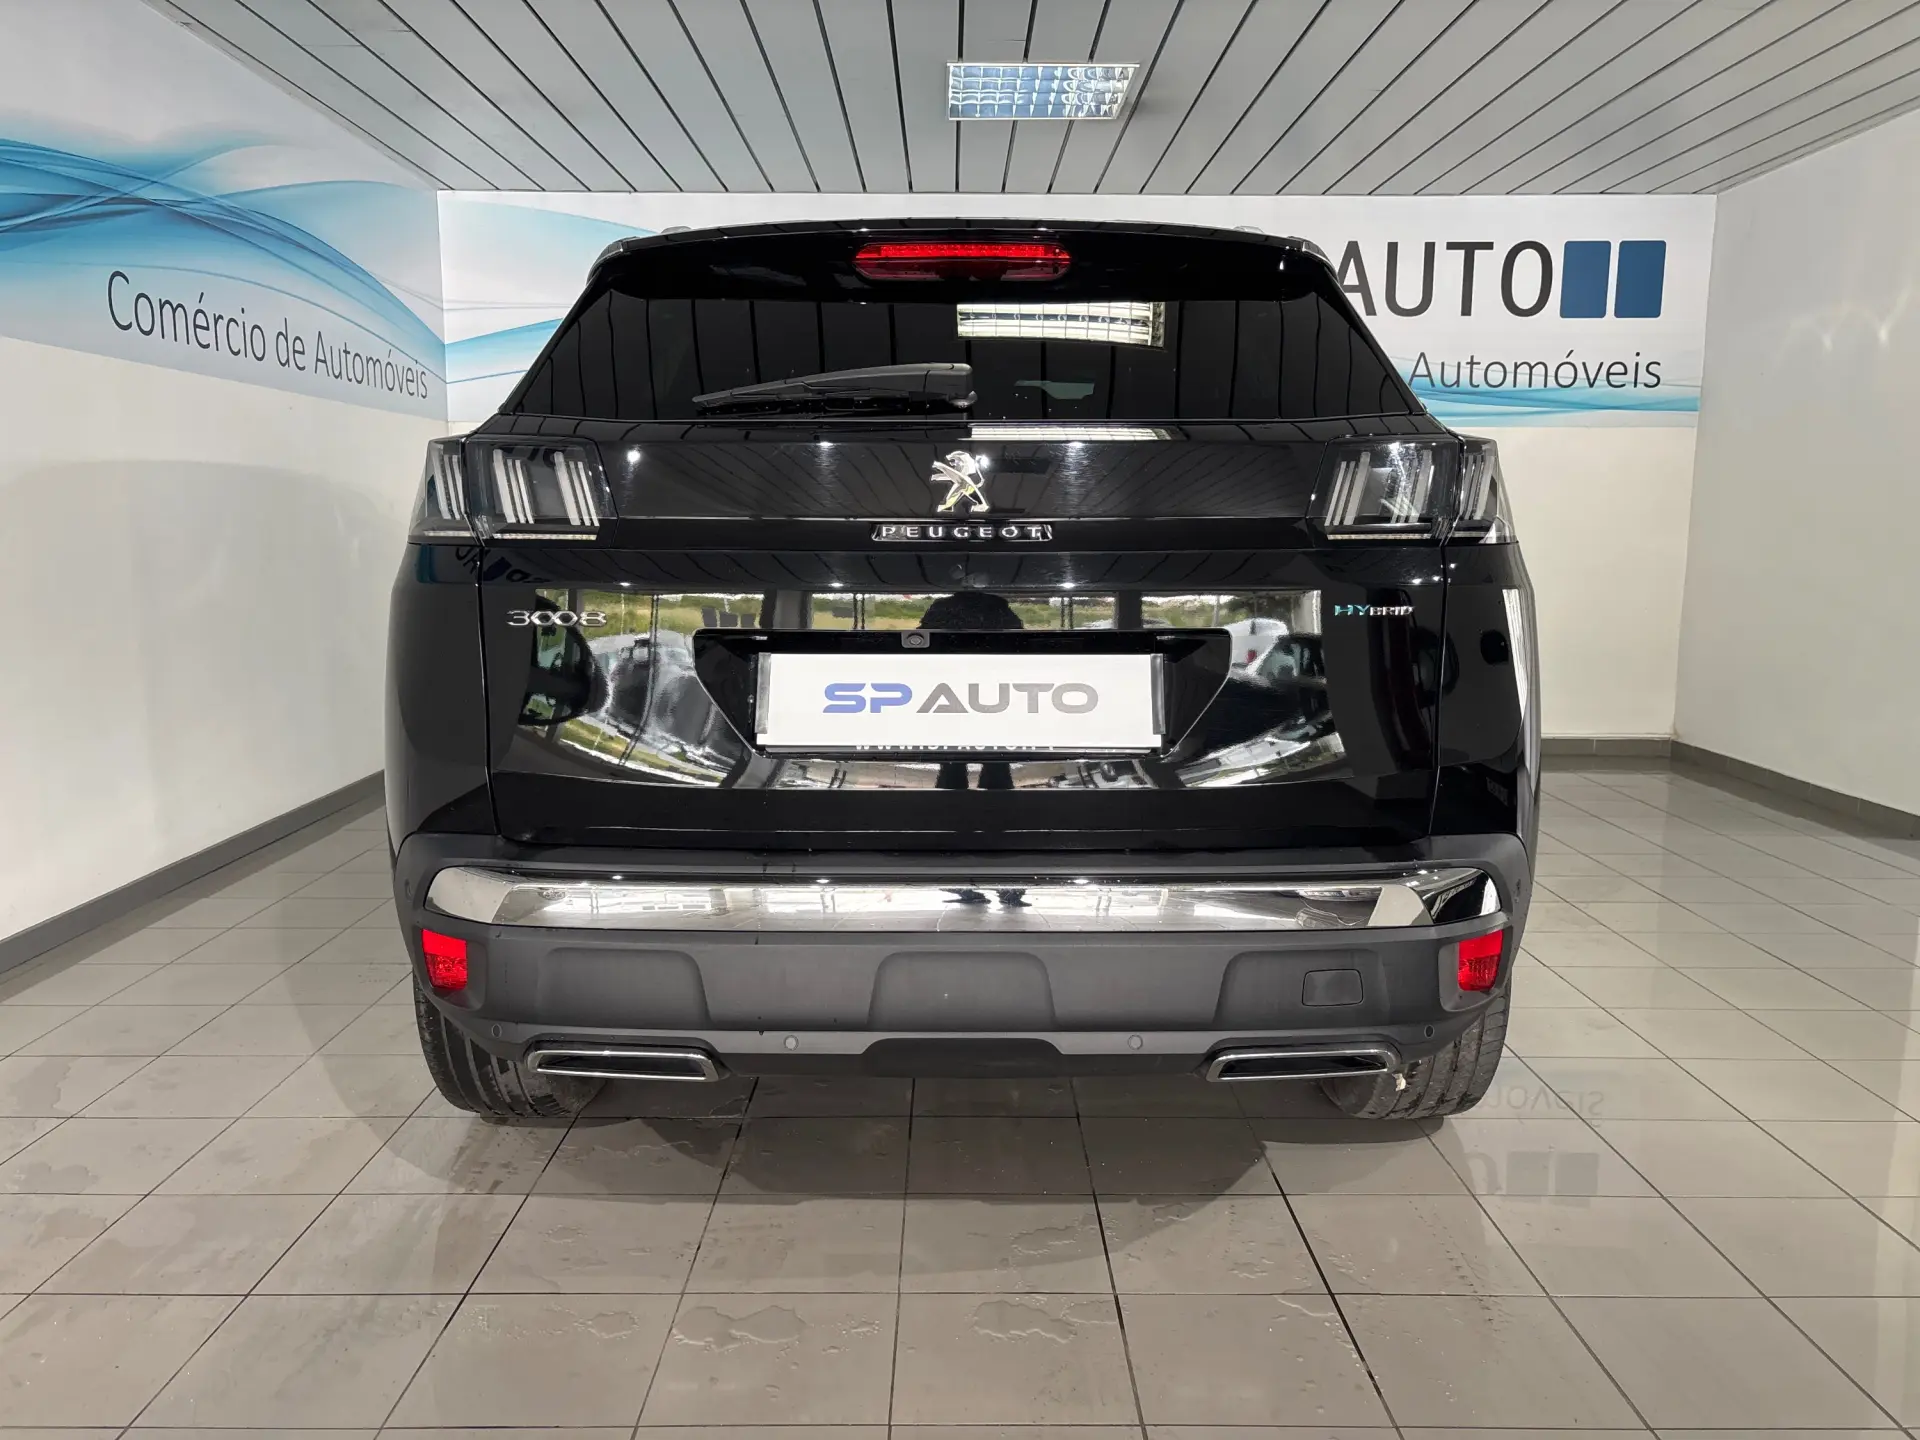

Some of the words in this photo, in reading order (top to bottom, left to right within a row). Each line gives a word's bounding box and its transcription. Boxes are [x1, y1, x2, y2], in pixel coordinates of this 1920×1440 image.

[1337, 240, 1554, 317] AUTO
[107, 270, 266, 362] Comércio
[275, 317, 306, 371] de
[314, 330, 428, 399] Automóveis
[1409, 350, 1662, 389] Automóveis
[881, 526, 1042, 538] PEUGEOT
[506, 610, 607, 627] 3008
[1334, 604, 1415, 616] HYBRID
